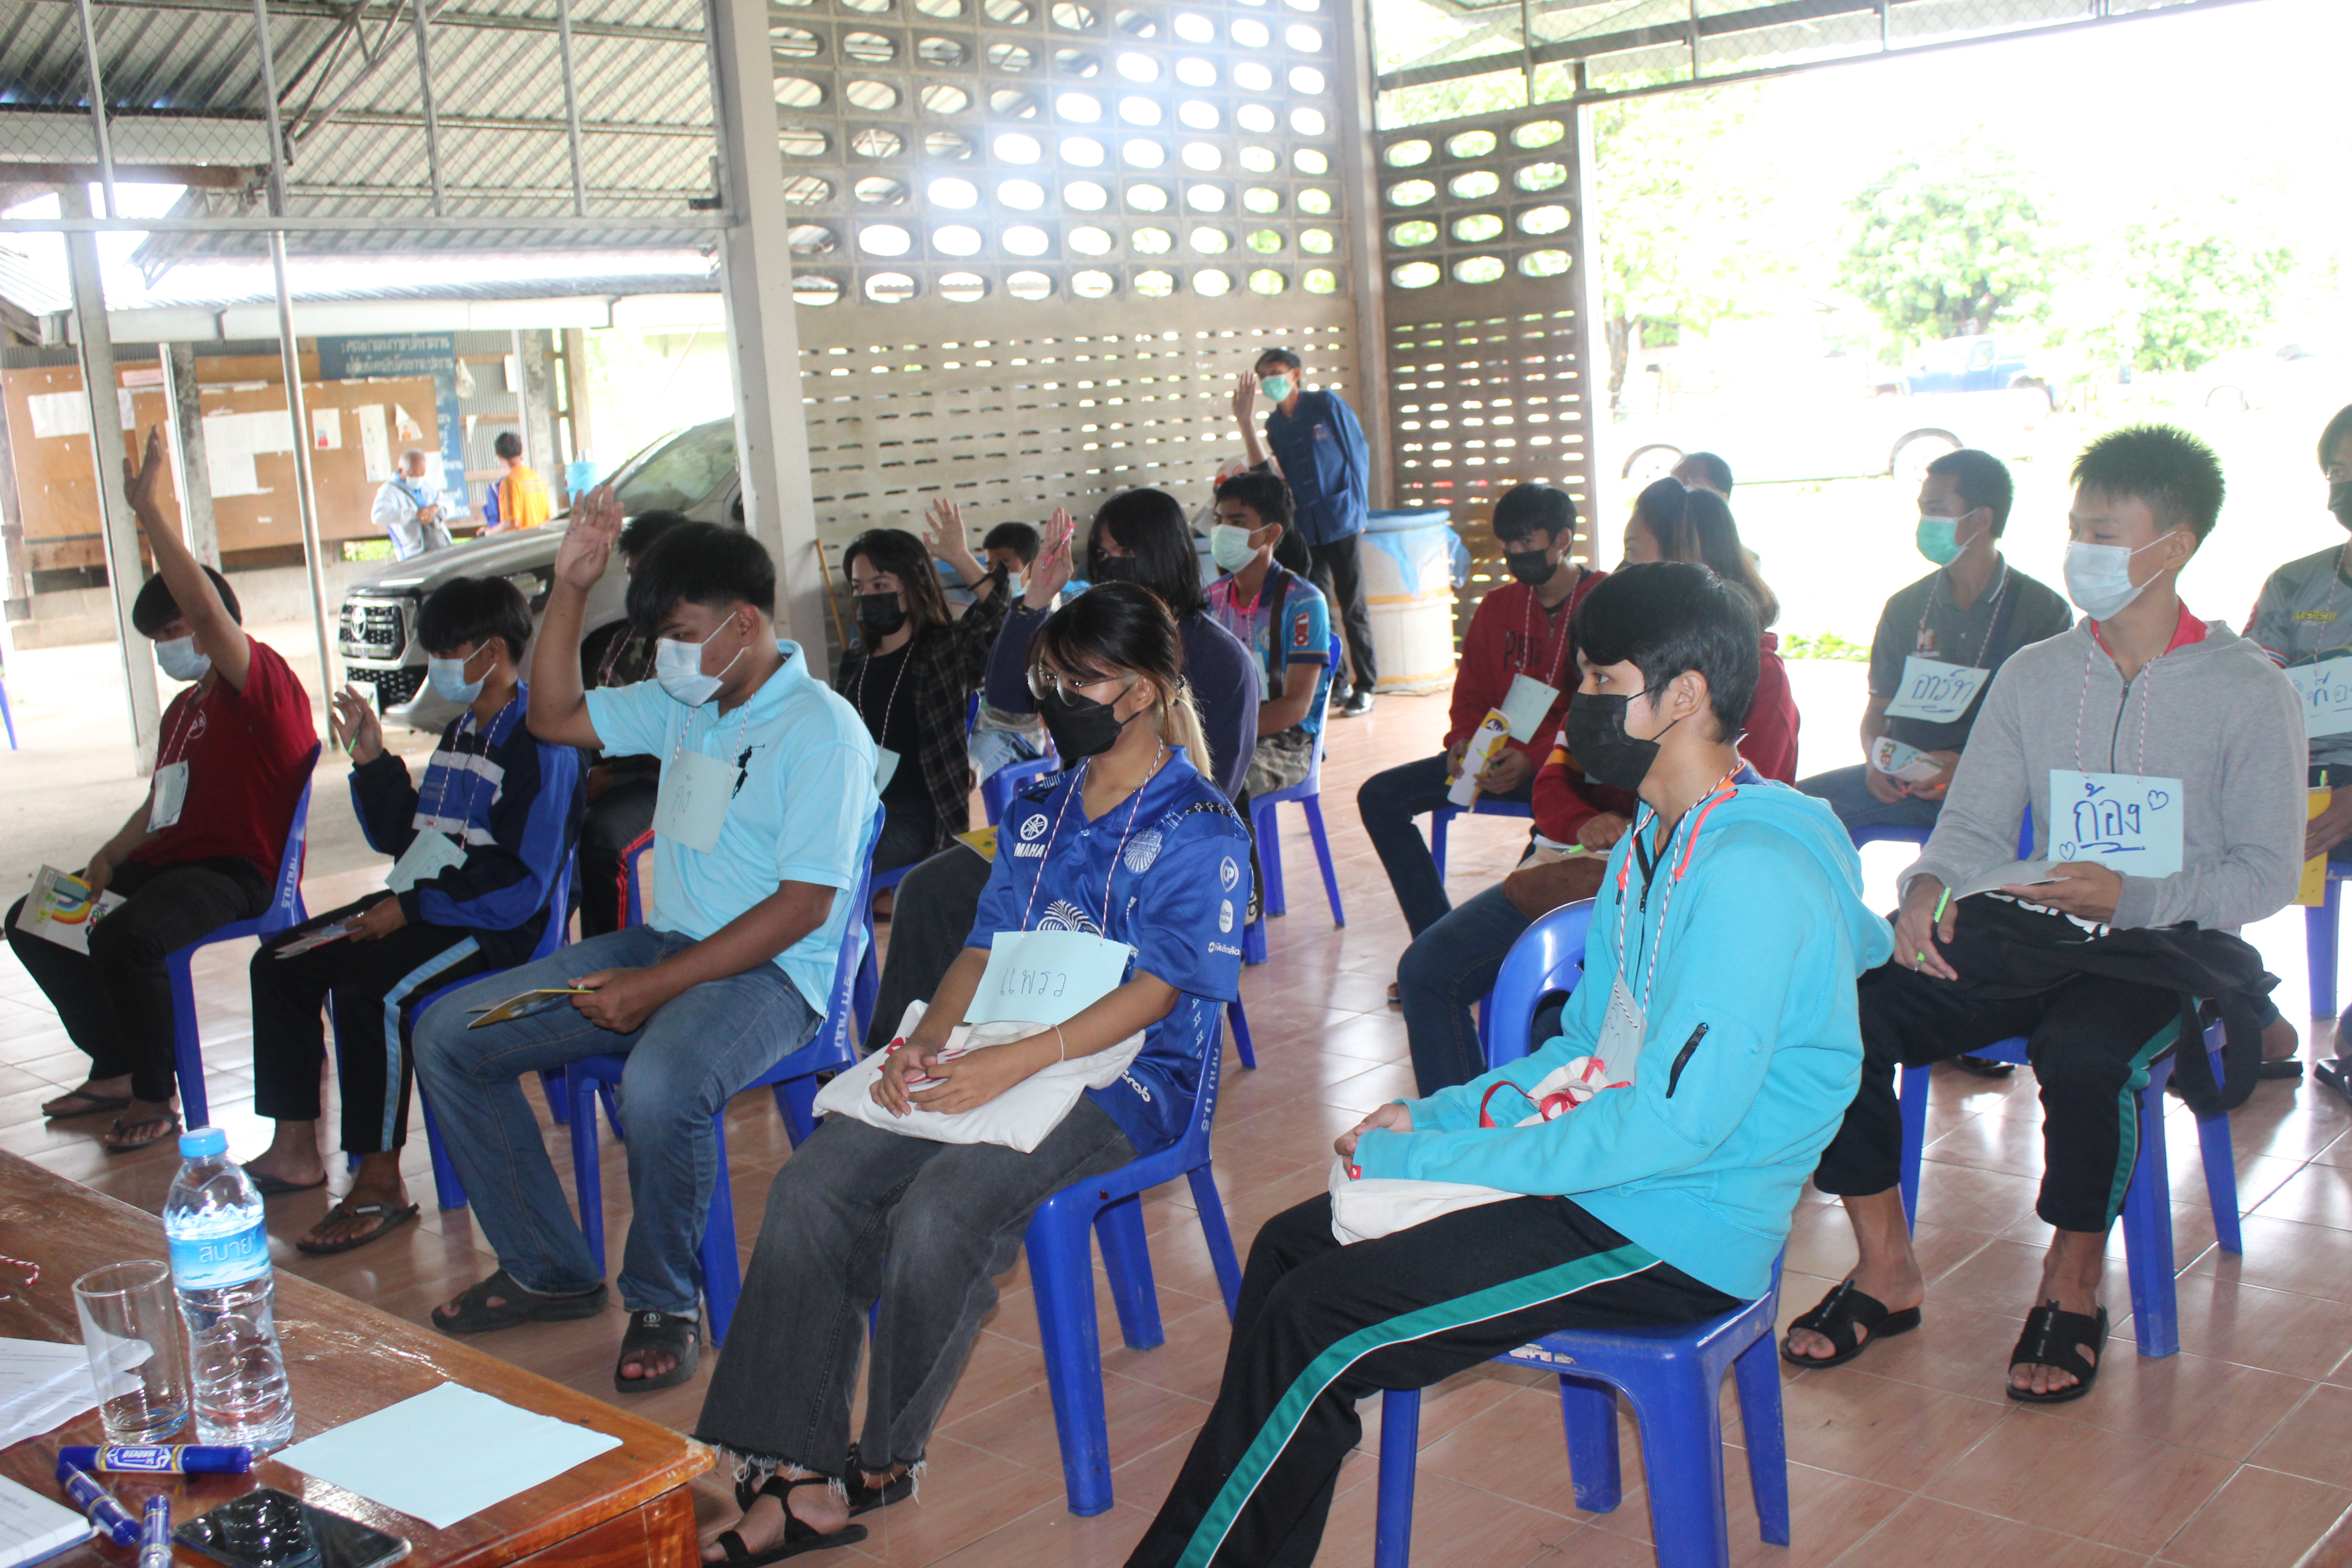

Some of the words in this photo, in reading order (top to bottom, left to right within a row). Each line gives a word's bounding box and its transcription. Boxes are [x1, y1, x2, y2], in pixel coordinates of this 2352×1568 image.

[2073, 782, 2141, 843] ก้อง
[1014, 842, 1045, 858] MAHA
[1129, 843, 1156, 853] BURIRAM
[1000, 968, 1066, 997] แพรว
